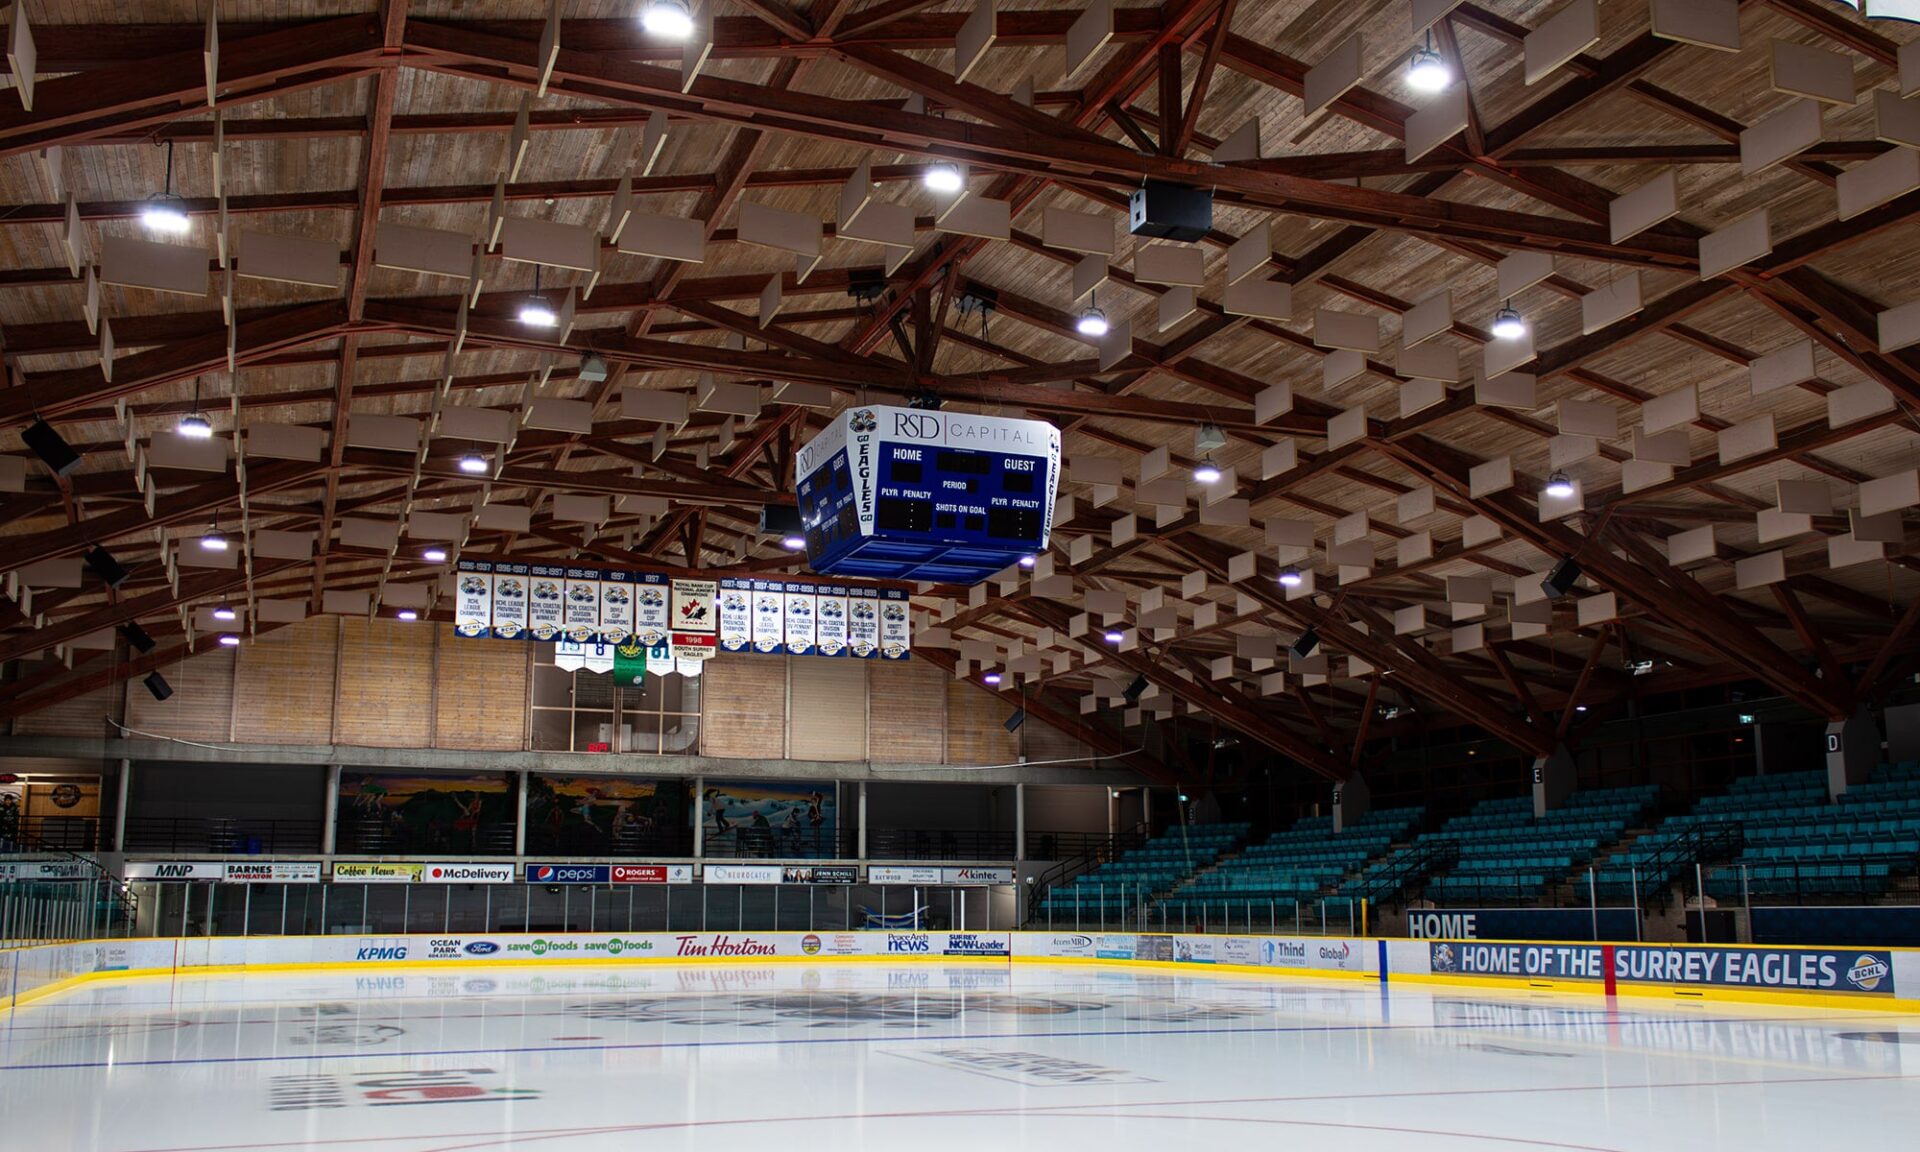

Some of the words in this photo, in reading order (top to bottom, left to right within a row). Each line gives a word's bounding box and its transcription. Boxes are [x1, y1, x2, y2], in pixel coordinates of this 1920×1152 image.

[894, 412, 940, 439] RSD
[950, 424, 1034, 444] CAPITAL
[858, 434, 870, 442] GO
[893, 448, 922, 460] HOME
[1004, 458, 1035, 472] GUEST
[858, 444, 872, 512] EAGLES
[943, 480, 967, 490] PERIOD
[881, 488, 898, 496] PLYR
[903, 490, 932, 499] PENALTY
[936, 503, 957, 512] SHOTS
[958, 505, 968, 513] ON
[969, 506, 986, 514] GOAL
[992, 498, 1008, 506] PLYR
[1012, 499, 1040, 508] PENALTY
[610, 572, 625, 580] 1997
[685, 636, 703, 644] 1998
[1828, 734, 1838, 752] D
[1534, 768, 1541, 784] E
[1333, 792, 1340, 804] F
[154, 864, 194, 876] MNP
[228, 865, 272, 874] BARNES
[337, 866, 366, 876] Coffee
[371, 866, 395, 876] News
[443, 868, 510, 882] McDelivery
[557, 868, 596, 881] pepsi
[970, 868, 997, 880] kintec
[1409, 914, 1477, 939] HOME
[676, 934, 708, 956] Tim
[710, 934, 776, 956] Hortons
[888, 940, 929, 952] news
[1071, 936, 1086, 946] MRI
[356, 946, 408, 960] KPMG
[470, 943, 492, 954] Ford
[1278, 942, 1305, 958] Thind
[1320, 946, 1346, 960] Global
[1462, 946, 1520, 973] HOME
[1525, 948, 1552, 975] OF
[1557, 948, 1602, 977] THE
[1614, 950, 1719, 982] SURREY
[1725, 953, 1837, 987] EAGLES
[1854, 965, 1882, 979] BCHL
